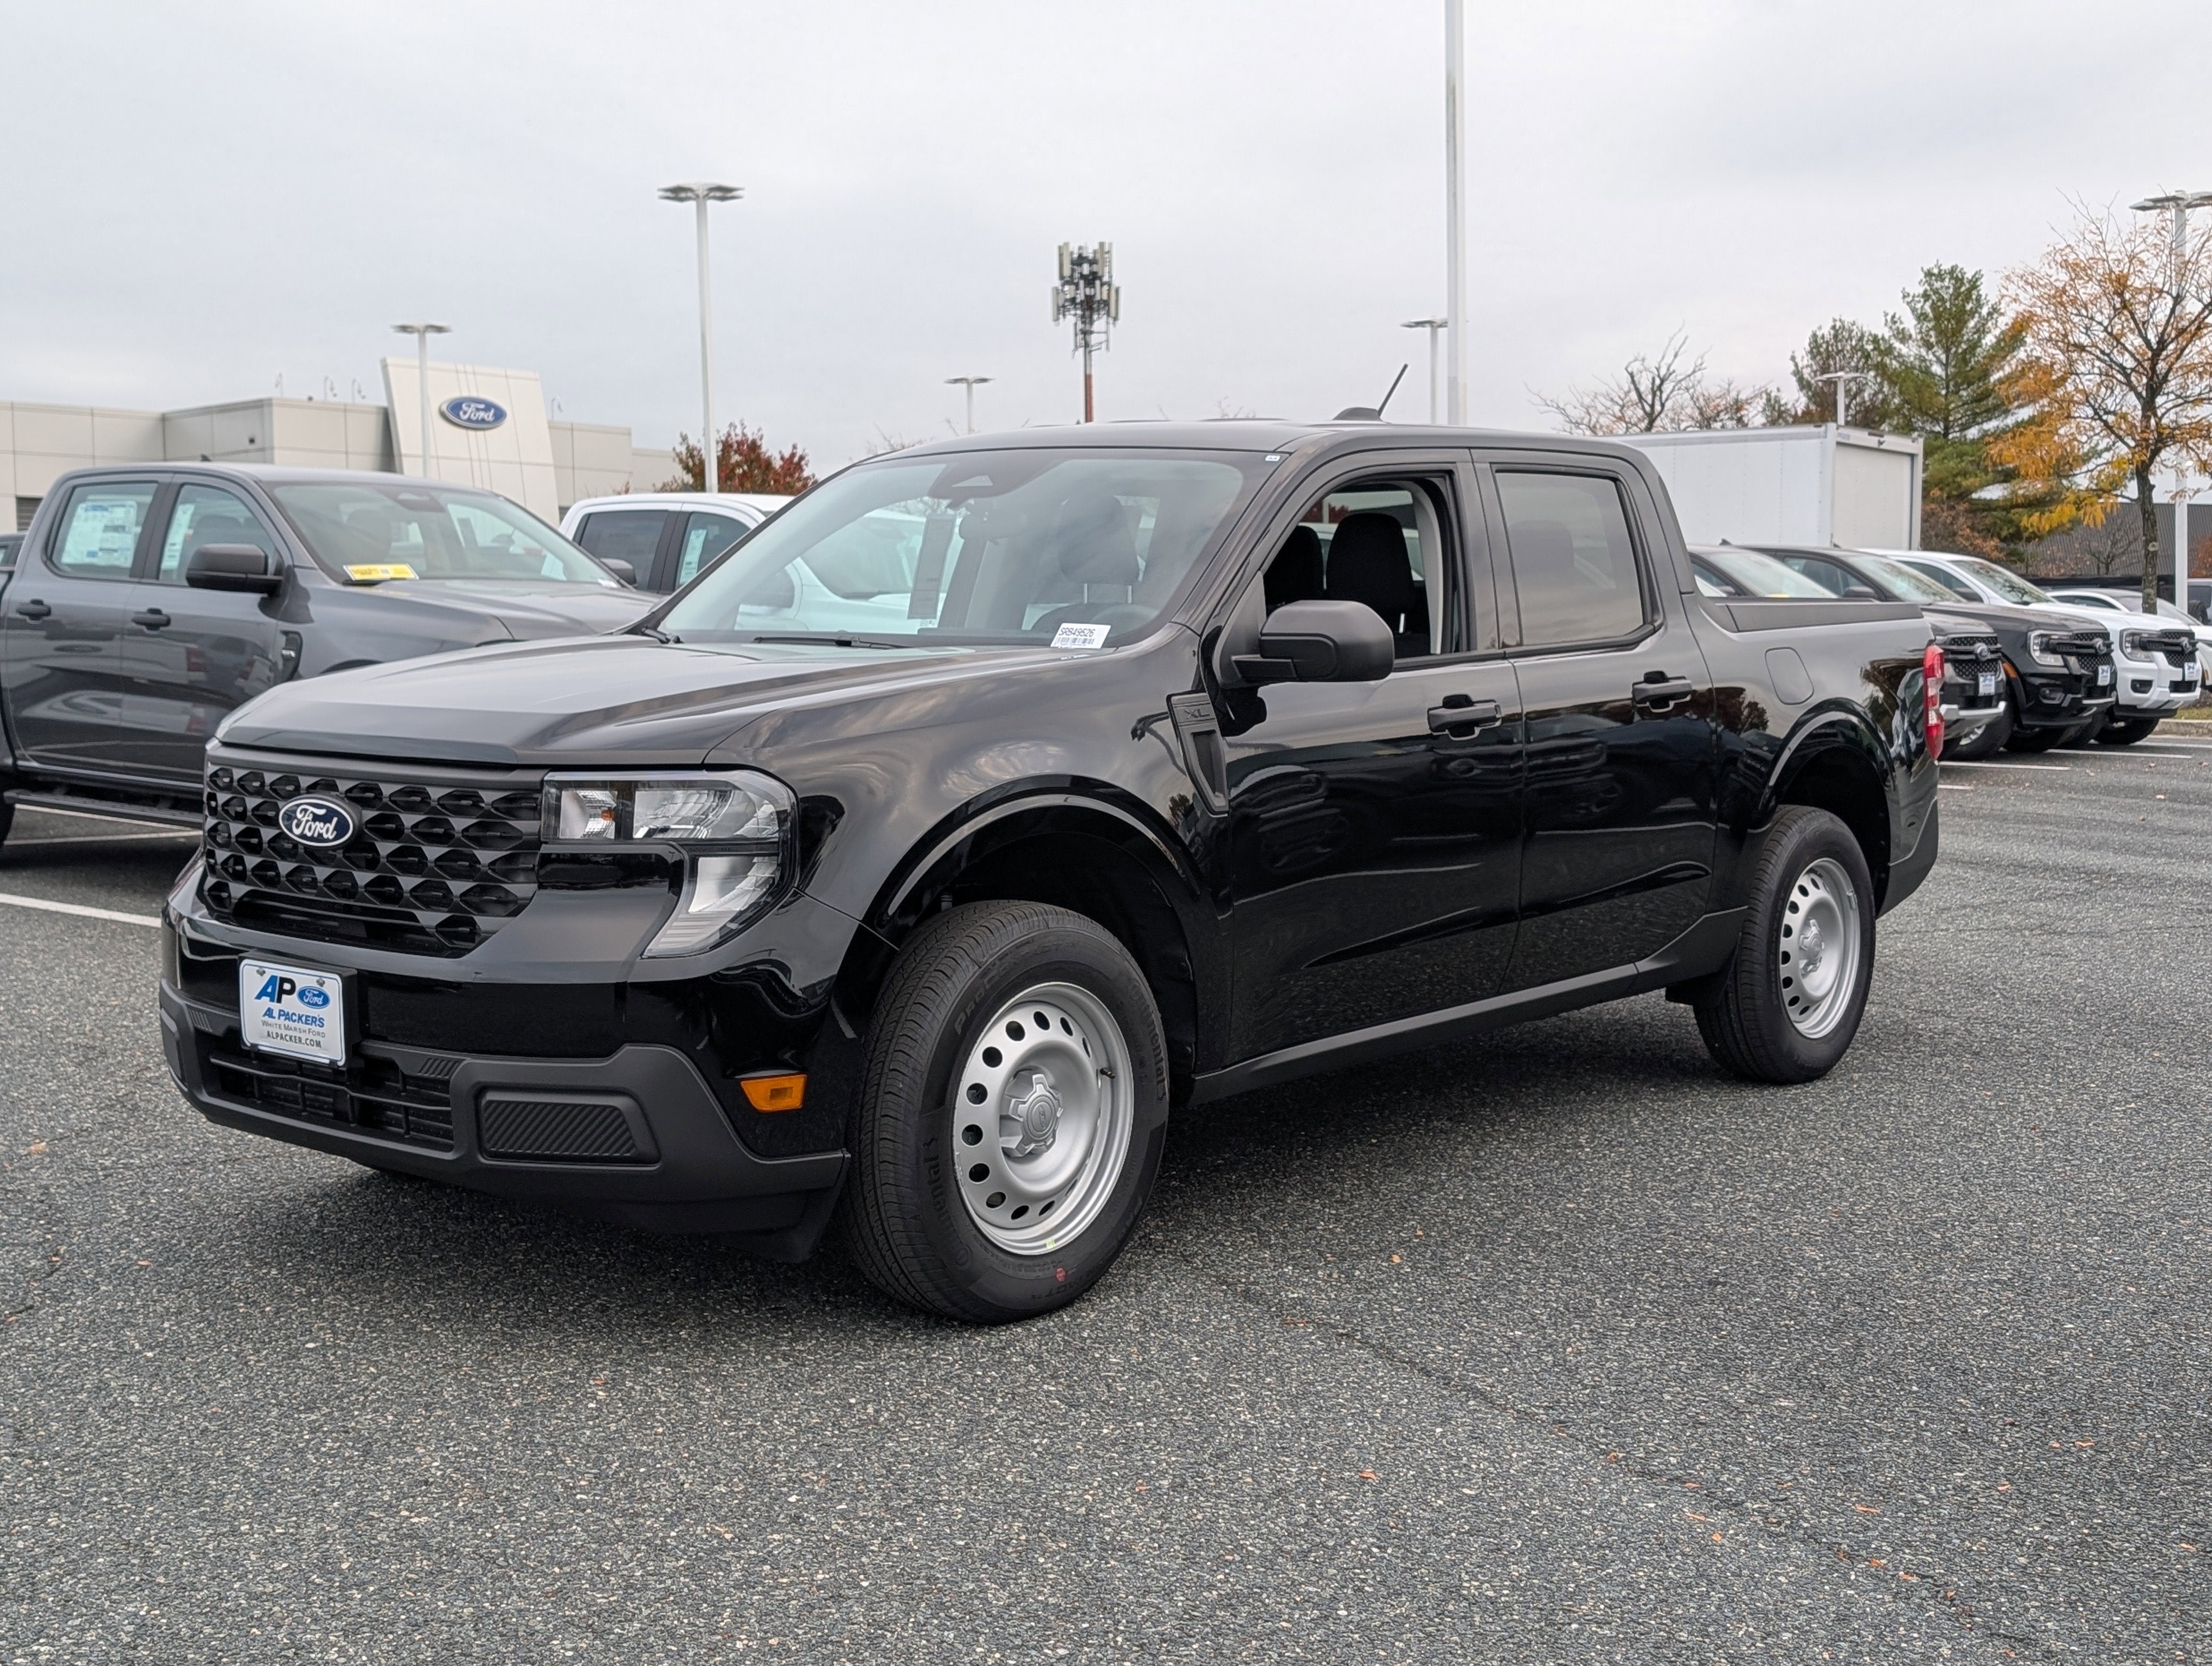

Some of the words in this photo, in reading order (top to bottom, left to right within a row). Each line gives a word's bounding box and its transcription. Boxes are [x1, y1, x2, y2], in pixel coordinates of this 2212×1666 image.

[460, 402, 495, 421] Ford
[1185, 709, 1210, 720] XL
[292, 804, 338, 840] Ford
[254, 975, 296, 1004] AP
[303, 989, 324, 1005] Ford
[262, 1007, 276, 1020] AL
[278, 1009, 325, 1028] PACKER'S
[261, 1020, 282, 1030] WHITE
[284, 1024, 307, 1034] MARSH
[308, 1028, 326, 1038] FORD
[267, 1030, 322, 1048] ALPACKER.COM
